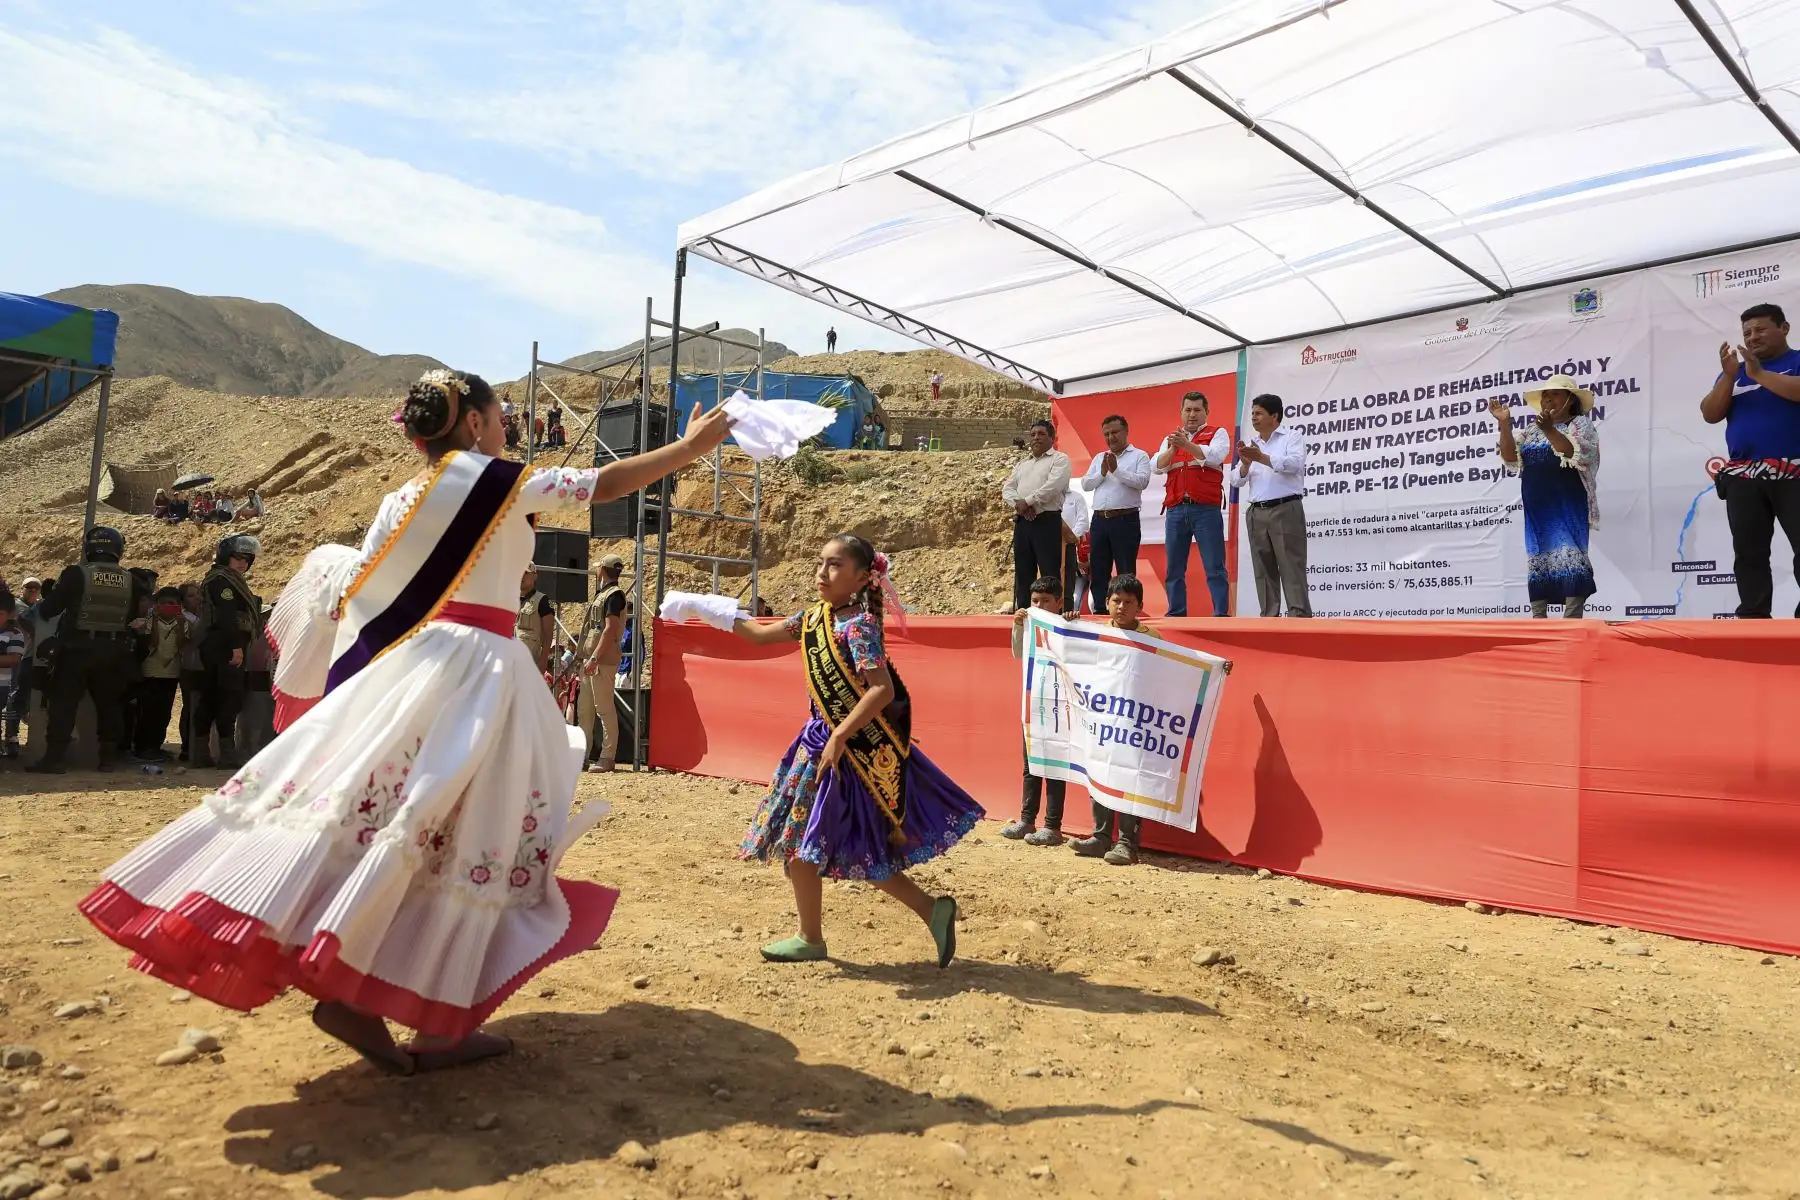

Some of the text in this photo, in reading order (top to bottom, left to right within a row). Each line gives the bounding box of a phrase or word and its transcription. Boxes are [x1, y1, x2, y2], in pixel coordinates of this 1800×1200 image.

[1725, 264, 1780, 280] Siempre
[1744, 274, 1780, 288] pueblo
[1424, 335, 1462, 346] Gobierno
[1284, 356, 1611, 419] CIO DE LA OBRA DE REHABILITACIÓN Y
[1290, 414, 1388, 436] ORAMIENTO
[1391, 410, 1412, 426] DE
[1416, 407, 1435, 422] LA
[1439, 401, 1472, 419] RED
[1324, 440, 1348, 454] KM
[1352, 436, 1372, 451] EN
[1375, 421, 1494, 448] TRAYECTORIA:
[1328, 452, 1405, 475] Tanguche)
[1355, 476, 1399, 493] PE-12
[1402, 470, 1464, 489] (Puente
[1306, 518, 1340, 528] uperficie
[1353, 515, 1389, 523] rodadura
[1398, 511, 1419, 520] nivel
[1505, 503, 1523, 513] que
[1324, 528, 1353, 537] 47.553
[1410, 521, 1463, 531] alcantarillas
[1464, 521, 1471, 530] y
[1472, 517, 1513, 527] badenes.
[1306, 560, 1451, 574] eficiarios: 33 mil habitantes.
[1674, 562, 1714, 571] Rinconada
[93, 572, 124, 583] POLICIA
[1319, 582, 1333, 591] de
[1335, 580, 1385, 591] inversión:
[1388, 578, 1401, 590] S/
[1403, 576, 1473, 589] 75,635,885.11
[1343, 609, 1351, 617] la
[1352, 609, 1376, 617] ARCC
[1378, 610, 1384, 618] y
[1385, 608, 1428, 617] ejecutada
[1429, 608, 1444, 616] por
[1446, 607, 1455, 615] la
[1456, 604, 1521, 615] Municipalidad
[1523, 603, 1564, 613] Dital
[1583, 603, 1612, 612] Chao
[1629, 606, 1674, 615] Guadalupito
[1073, 682, 1186, 735] Siempre
[1098, 722, 1180, 760] pueblo
